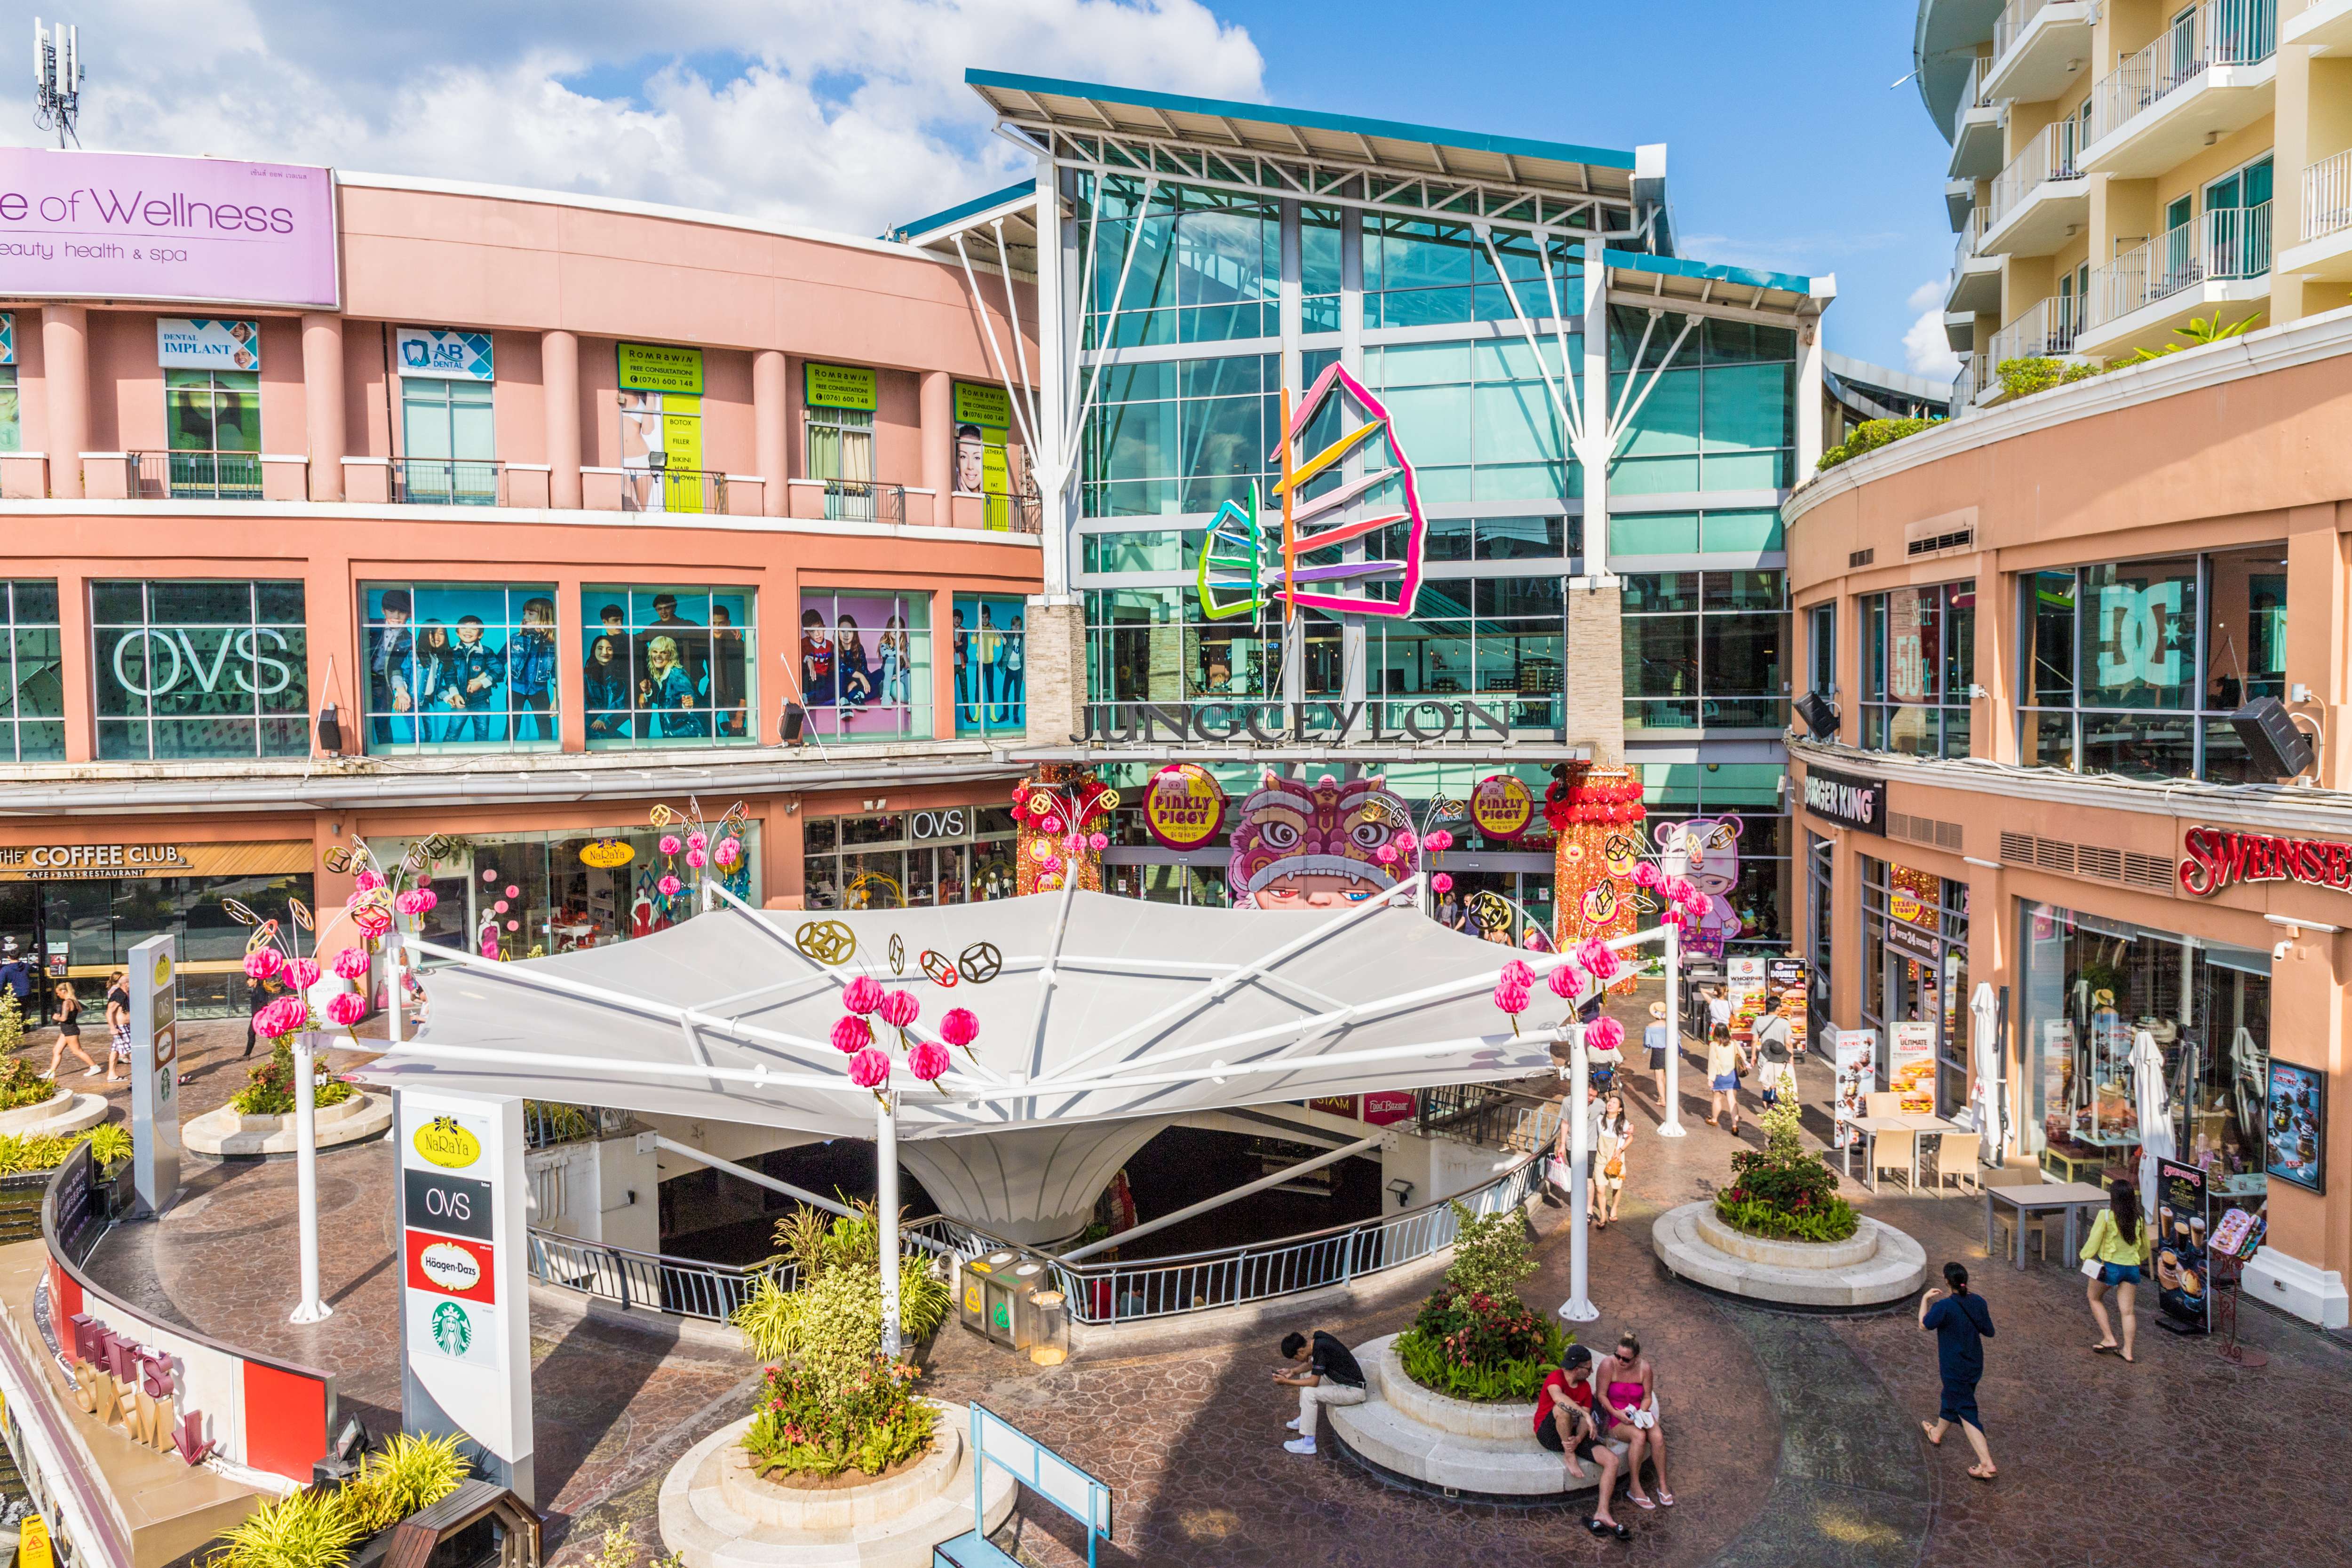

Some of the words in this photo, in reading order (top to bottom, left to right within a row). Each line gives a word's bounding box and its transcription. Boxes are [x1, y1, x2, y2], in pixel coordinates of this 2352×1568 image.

[40, 190, 84, 222] of
[90, 189, 294, 233] Wellness
[65, 241, 124, 259] health
[133, 249, 142, 259] &
[150, 248, 187, 263] spa
[164, 342, 231, 355] IMPLANT
[433, 343, 463, 360] AB
[639, 376, 660, 384] (076)
[645, 366, 693, 376] CONSULTATION!
[828, 385, 868, 394] CONSULTATION!
[1912, 598, 1932, 627] SALE
[113, 628, 291, 696] OVS
[1068, 700, 1510, 748] JUNGCEYLON
[1804, 775, 1838, 815] BURGER
[1839, 784, 1873, 823] KING
[913, 809, 964, 839] OVS
[1158, 810, 1209, 825] PIGGY
[1481, 810, 1522, 820] PIGGY
[32, 846, 123, 867] COFFEE
[129, 847, 177, 862] CLUB
[2179, 825, 2352, 897] SWENSE
[83, 869, 145, 878] RESTAURANT
[1907, 931, 1916, 946] 24
[1370, 1100, 1383, 1111] Food
[1383, 1100, 1408, 1112] Bazaar
[425, 1133, 469, 1156] NaRaYa
[426, 1188, 470, 1221] OVS
